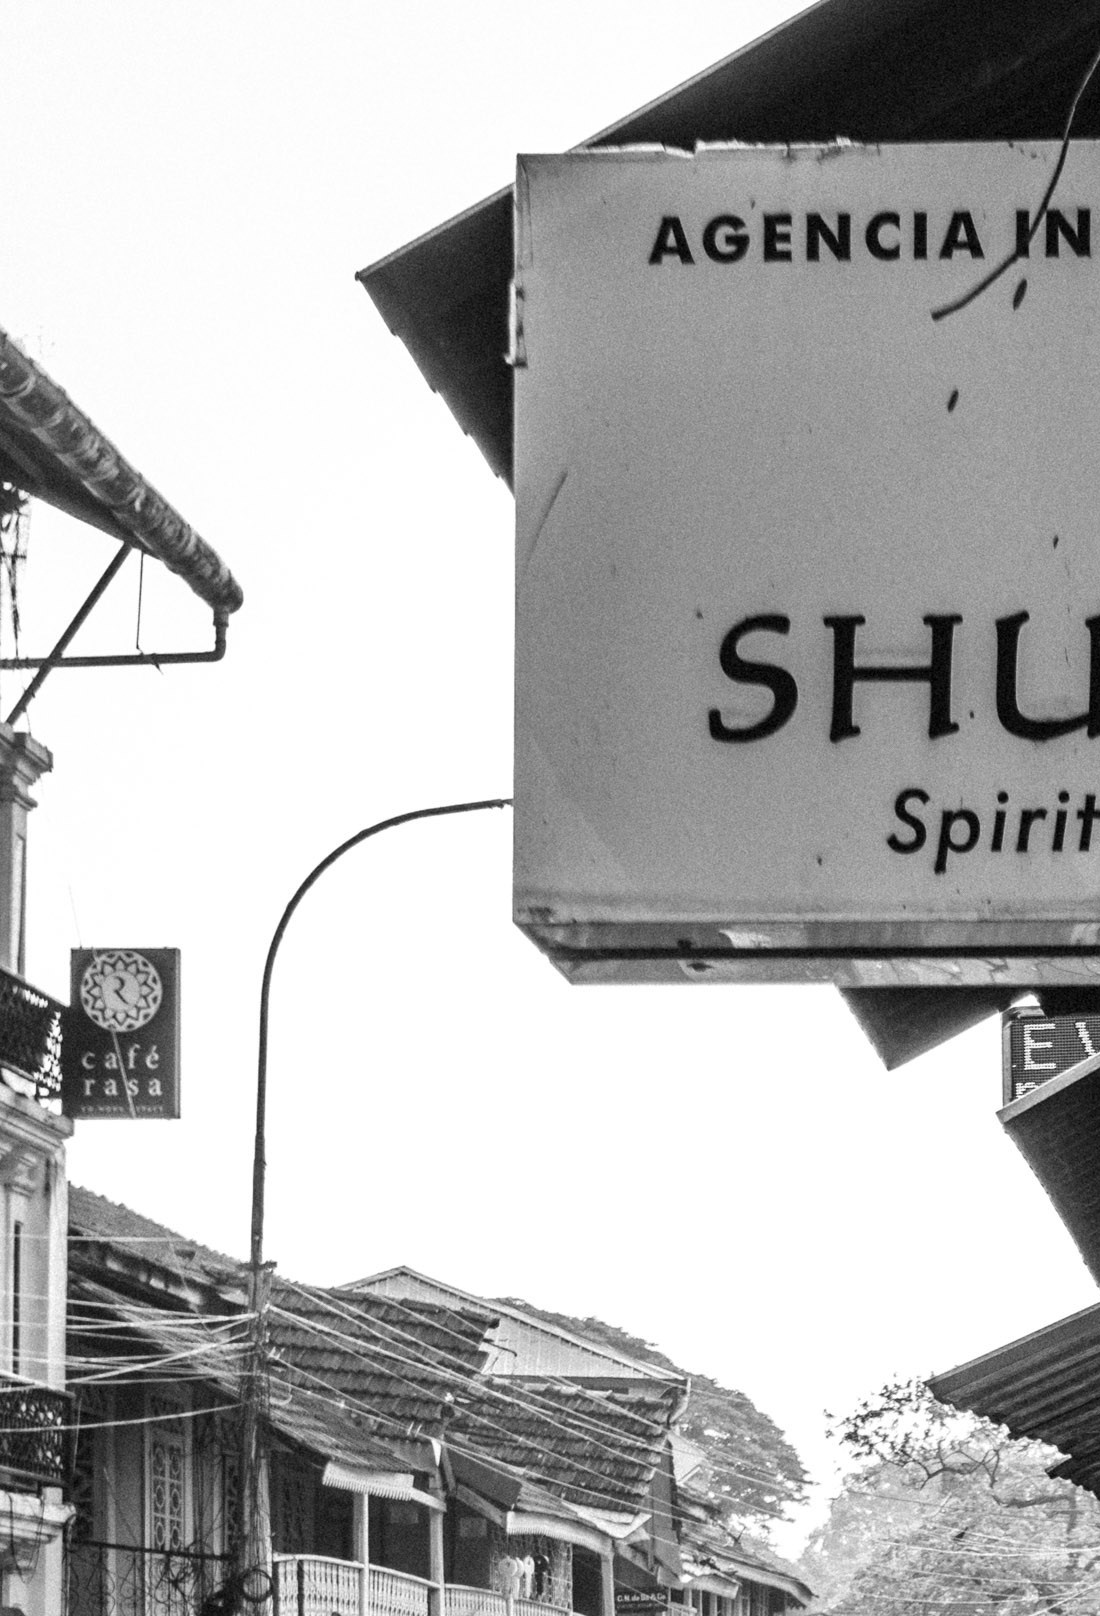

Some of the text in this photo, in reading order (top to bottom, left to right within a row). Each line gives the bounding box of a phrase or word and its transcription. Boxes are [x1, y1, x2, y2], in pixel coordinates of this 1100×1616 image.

[648, 210, 986, 265] AGENCIA
[82, 1043, 160, 1070] café
[84, 1078, 164, 1096] rasa
